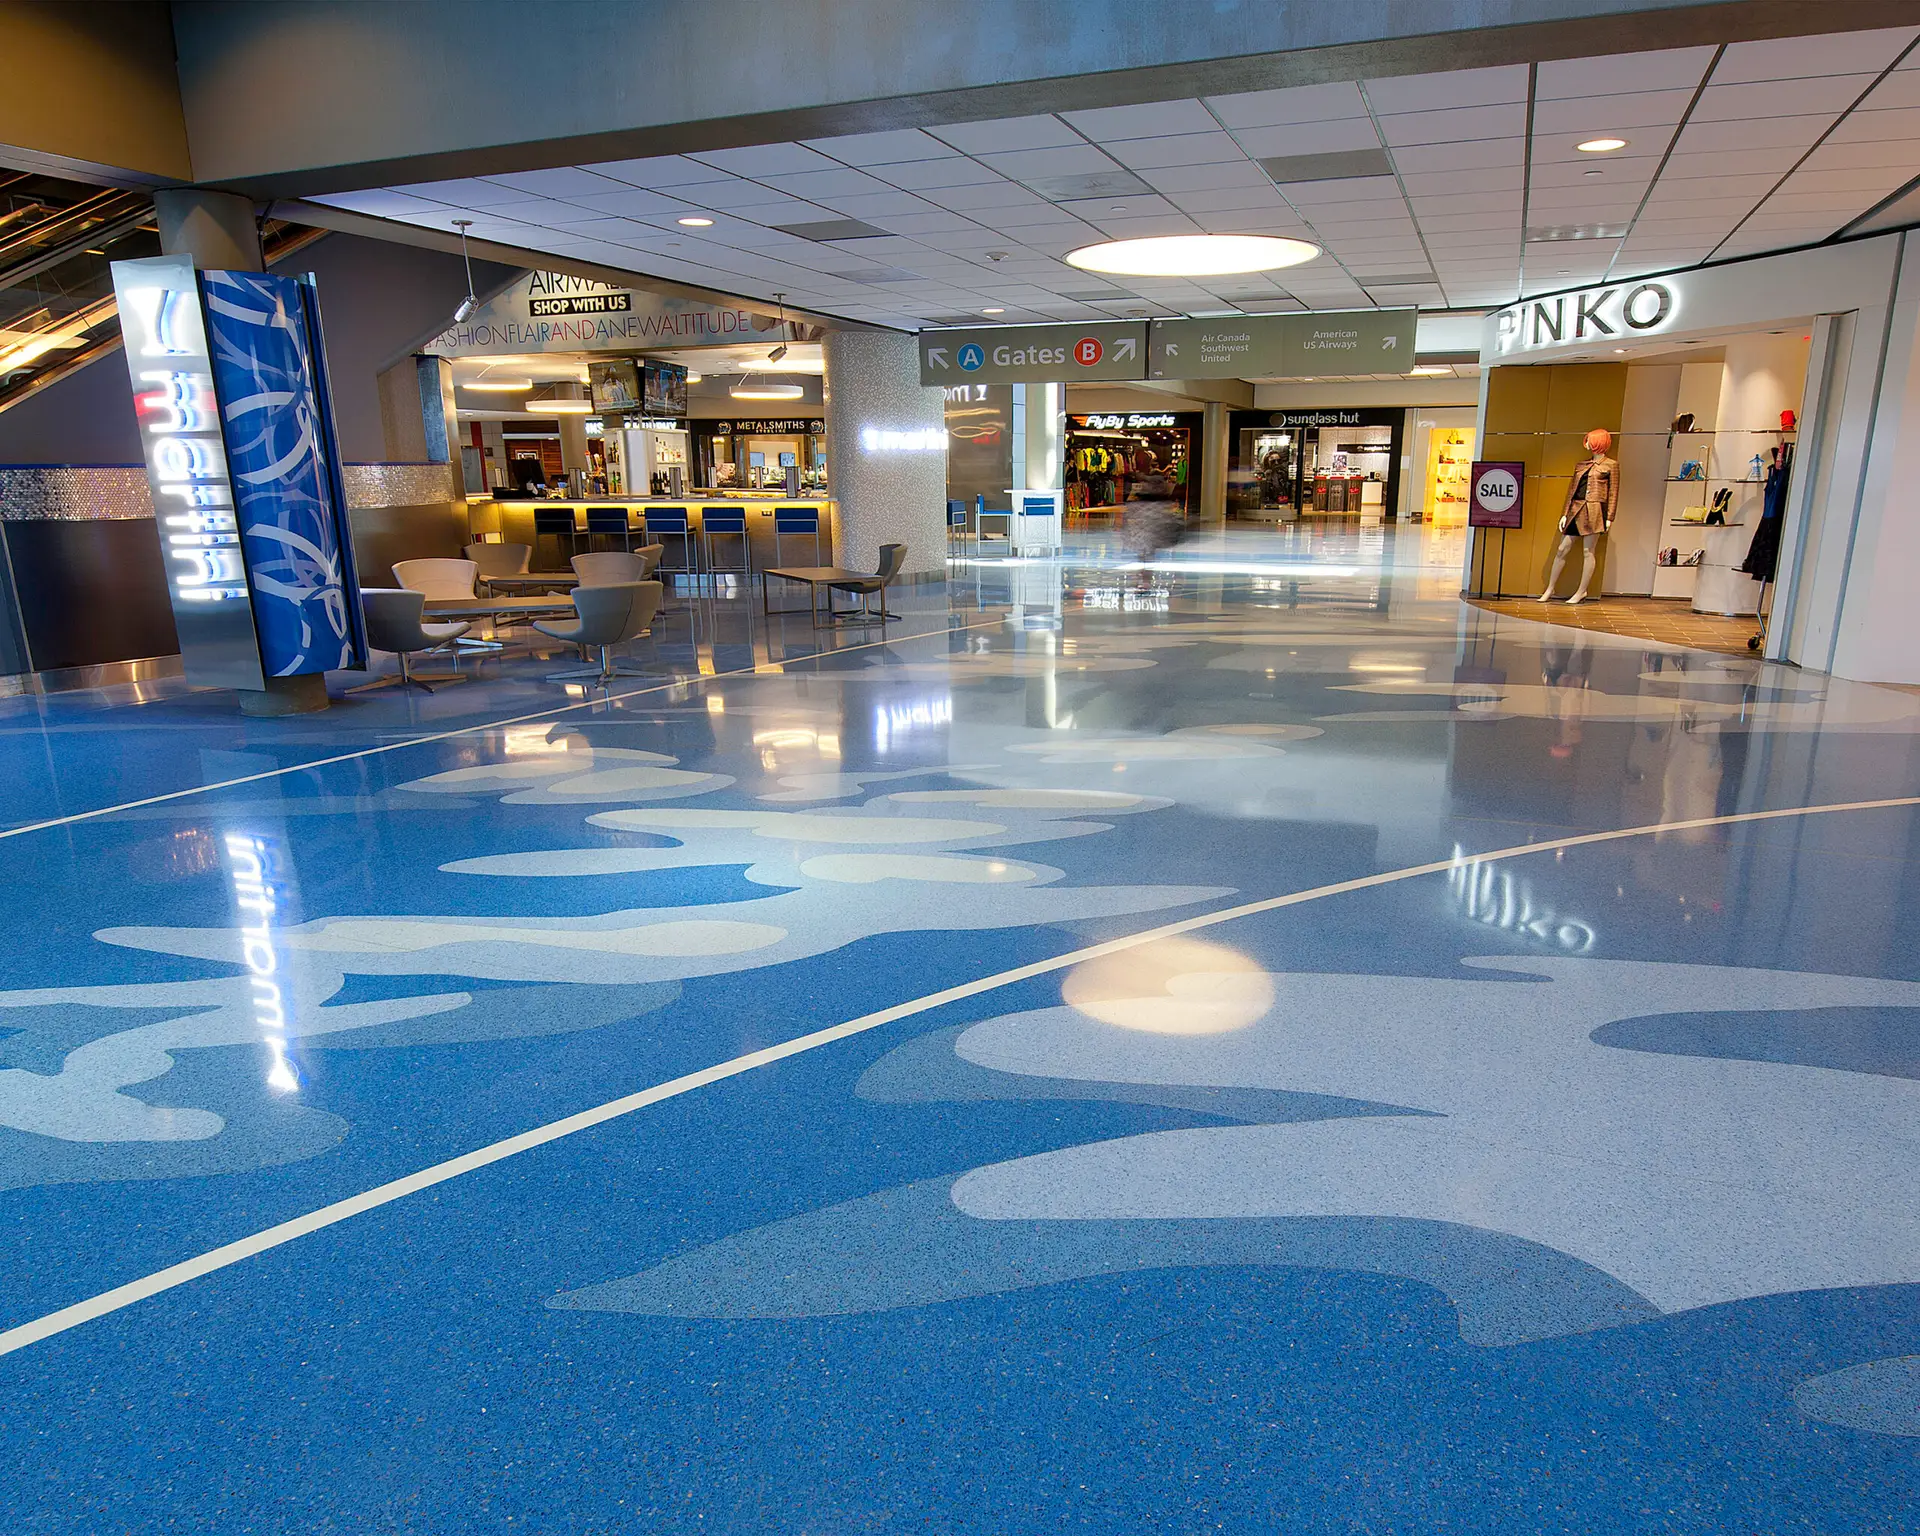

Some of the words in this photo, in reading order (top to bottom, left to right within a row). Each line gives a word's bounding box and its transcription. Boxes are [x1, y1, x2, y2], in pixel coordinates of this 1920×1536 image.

[533, 300, 569, 315] SHOP
[571, 297, 605, 312] WITH
[608, 295, 627, 310] US
[1495, 283, 1673, 352] PINKO
[1201, 334, 1215, 343] Air
[1217, 333, 1250, 342] Canada
[1313, 329, 1358, 339] American
[1201, 343, 1249, 353] Southwest
[1303, 341, 1319, 350] US
[1320, 340, 1357, 350] Airways
[962, 348, 980, 367] A
[992, 345, 1065, 367] Gates
[1081, 342, 1096, 361] B
[1201, 354, 1231, 363] United
[736, 420, 805, 430] METALSMITHS
[1085, 415, 1125, 429] FlyBy
[1127, 414, 1175, 428] Sports
[1288, 412, 1338, 427] sunglass
[1339, 412, 1360, 423] hut
[1480, 483, 1514, 498] SALE
